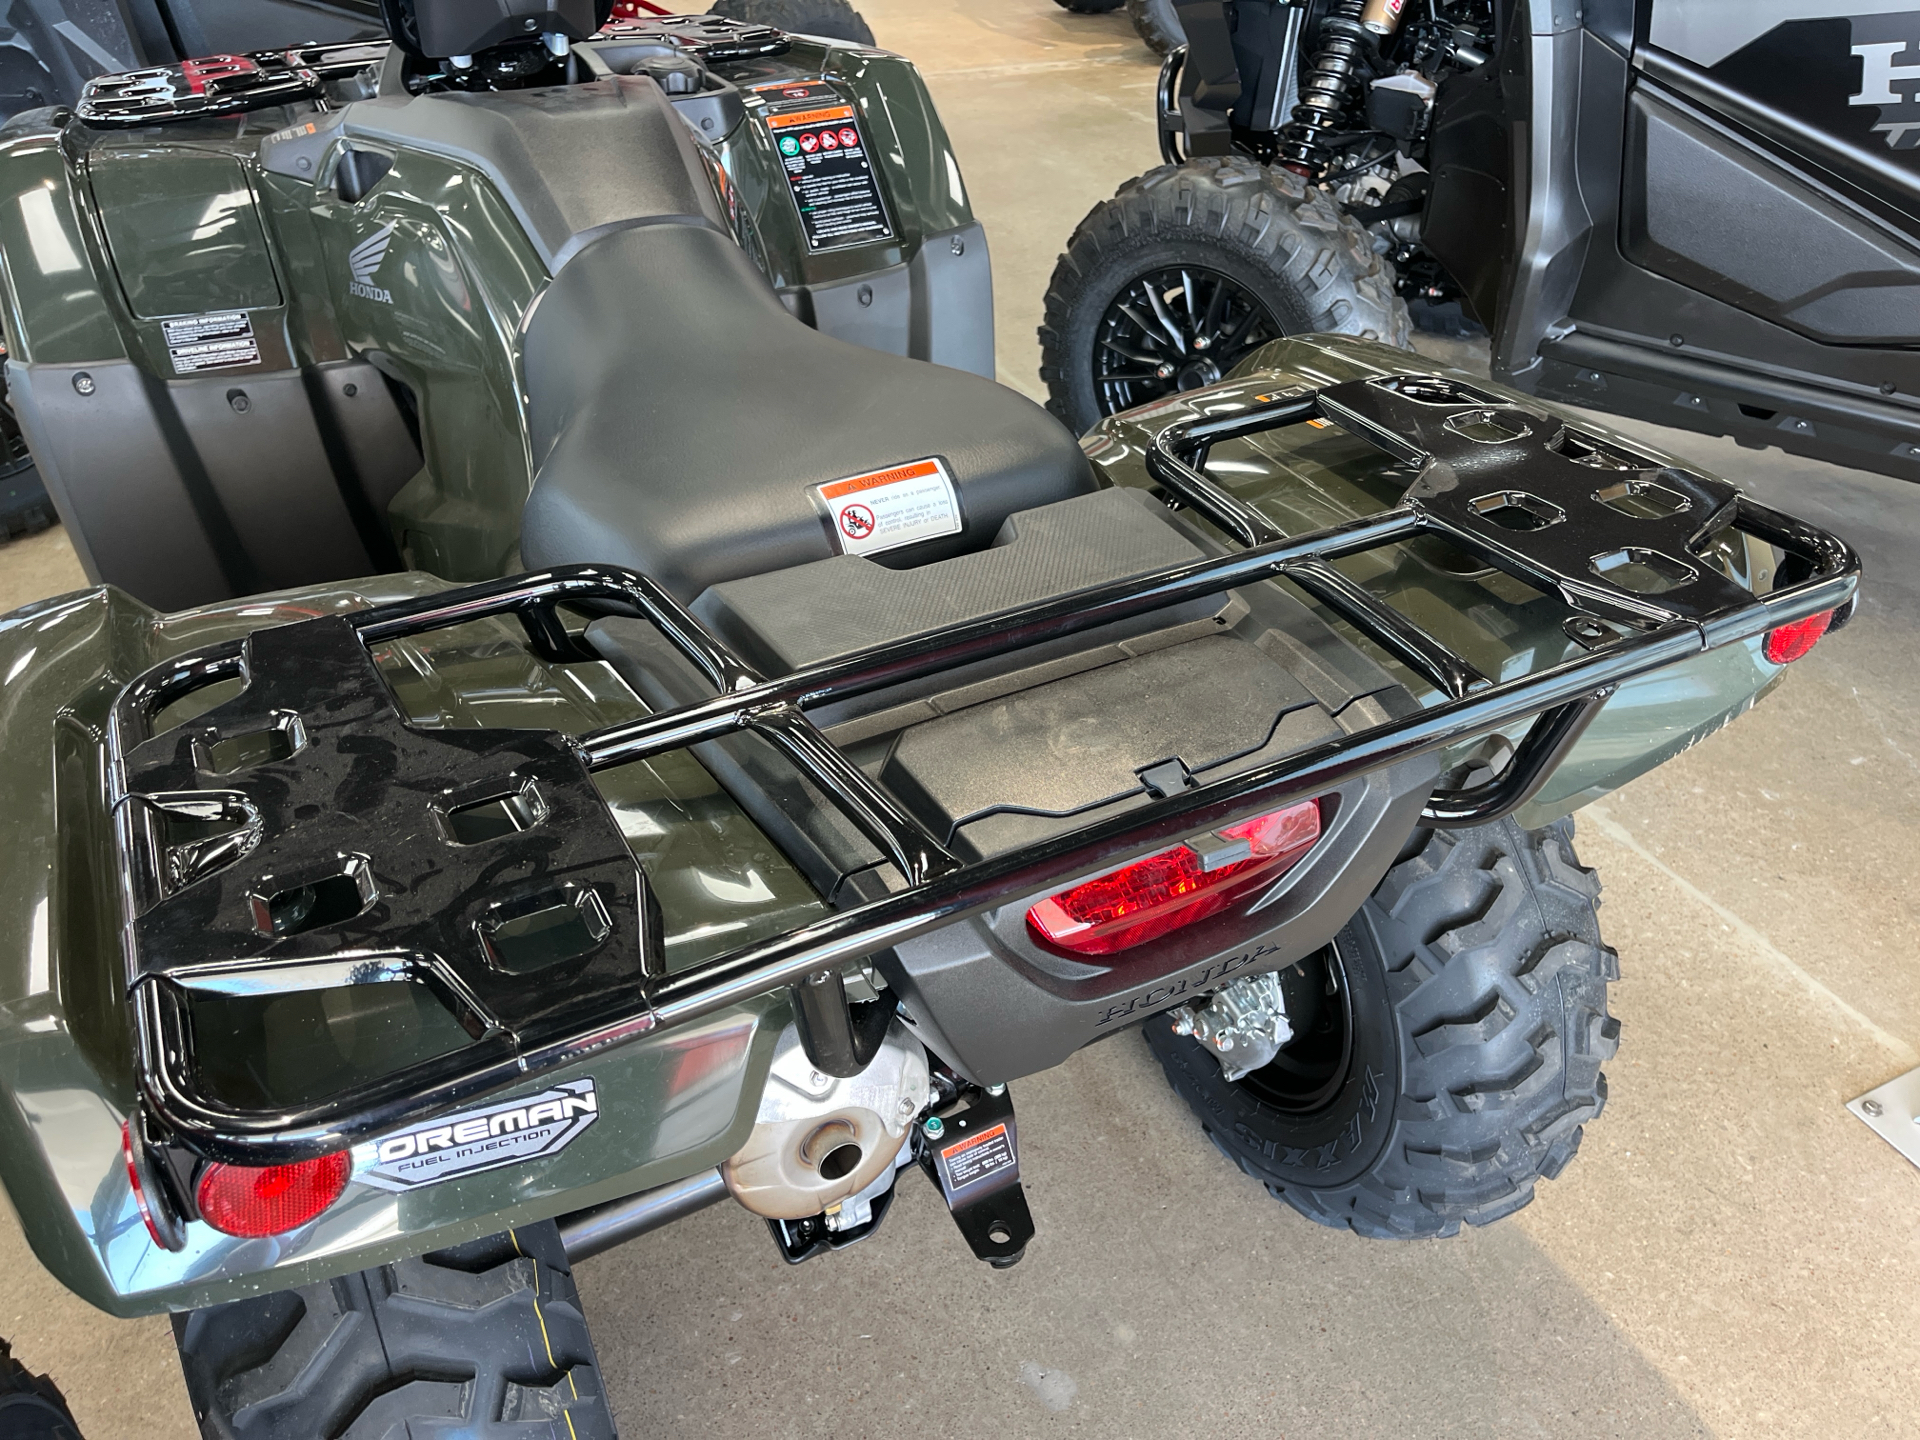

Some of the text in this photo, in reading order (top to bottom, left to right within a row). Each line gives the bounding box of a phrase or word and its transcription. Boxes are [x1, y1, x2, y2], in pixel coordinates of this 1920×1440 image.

[795, 111, 831, 121] WARNING
[349, 281, 394, 305] HONDA
[859, 468, 916, 488] WARNING
[870, 496, 889, 506] NEVER
[876, 509, 904, 520] Passengers
[880, 524, 901, 535] SEVERE
[902, 518, 922, 528] INJURY
[1094, 941, 1282, 1027] HONDA
[958, 1130, 995, 1149] WARNING
[397, 1129, 551, 1173] FUEL INJECTION
